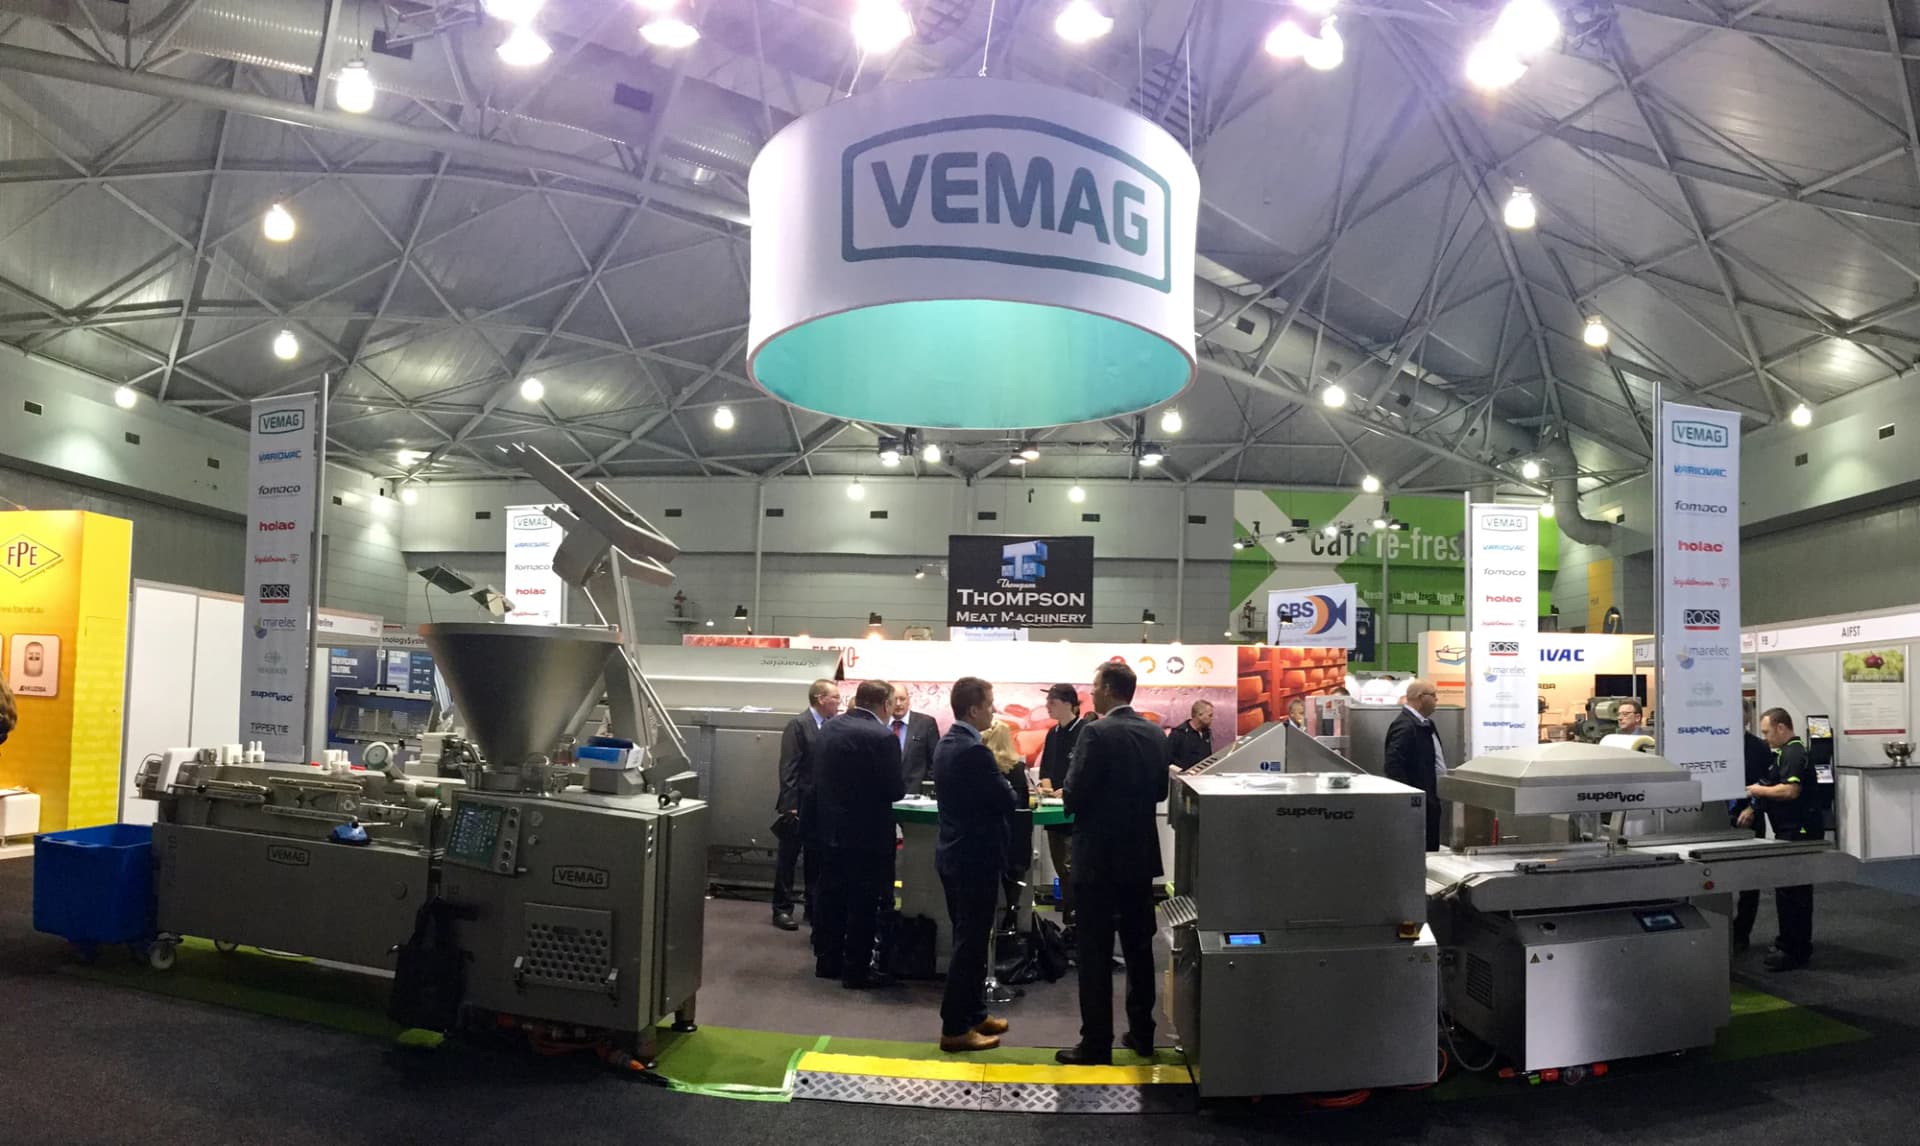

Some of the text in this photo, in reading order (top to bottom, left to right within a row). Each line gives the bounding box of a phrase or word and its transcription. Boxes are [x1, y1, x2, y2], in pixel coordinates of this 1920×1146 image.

[871, 151, 1149, 257] VEMAG
[263, 414, 300, 430] VEMAG
[1677, 425, 1722, 443] VEMAG
[1674, 500, 1728, 514] fomaco
[517, 518, 548, 527] VEMAG
[1486, 518, 1523, 528] VEMAG
[1376, 527, 1466, 561] re-fres
[1678, 540, 1723, 552] holac
[8, 541, 38, 568] FPE
[260, 585, 290, 598] ROSS
[957, 588, 1085, 607] THOMPSON
[956, 611, 1086, 623] MEAT MACHINERY
[1683, 609, 1720, 625] ROSS
[1841, 626, 1861, 637] AIFST
[1489, 641, 1519, 653] ROSS
[1577, 791, 1645, 803] supervac
[1276, 806, 1355, 820] supervac
[272, 849, 306, 862] VEMAG
[558, 869, 604, 885] VEMAG
